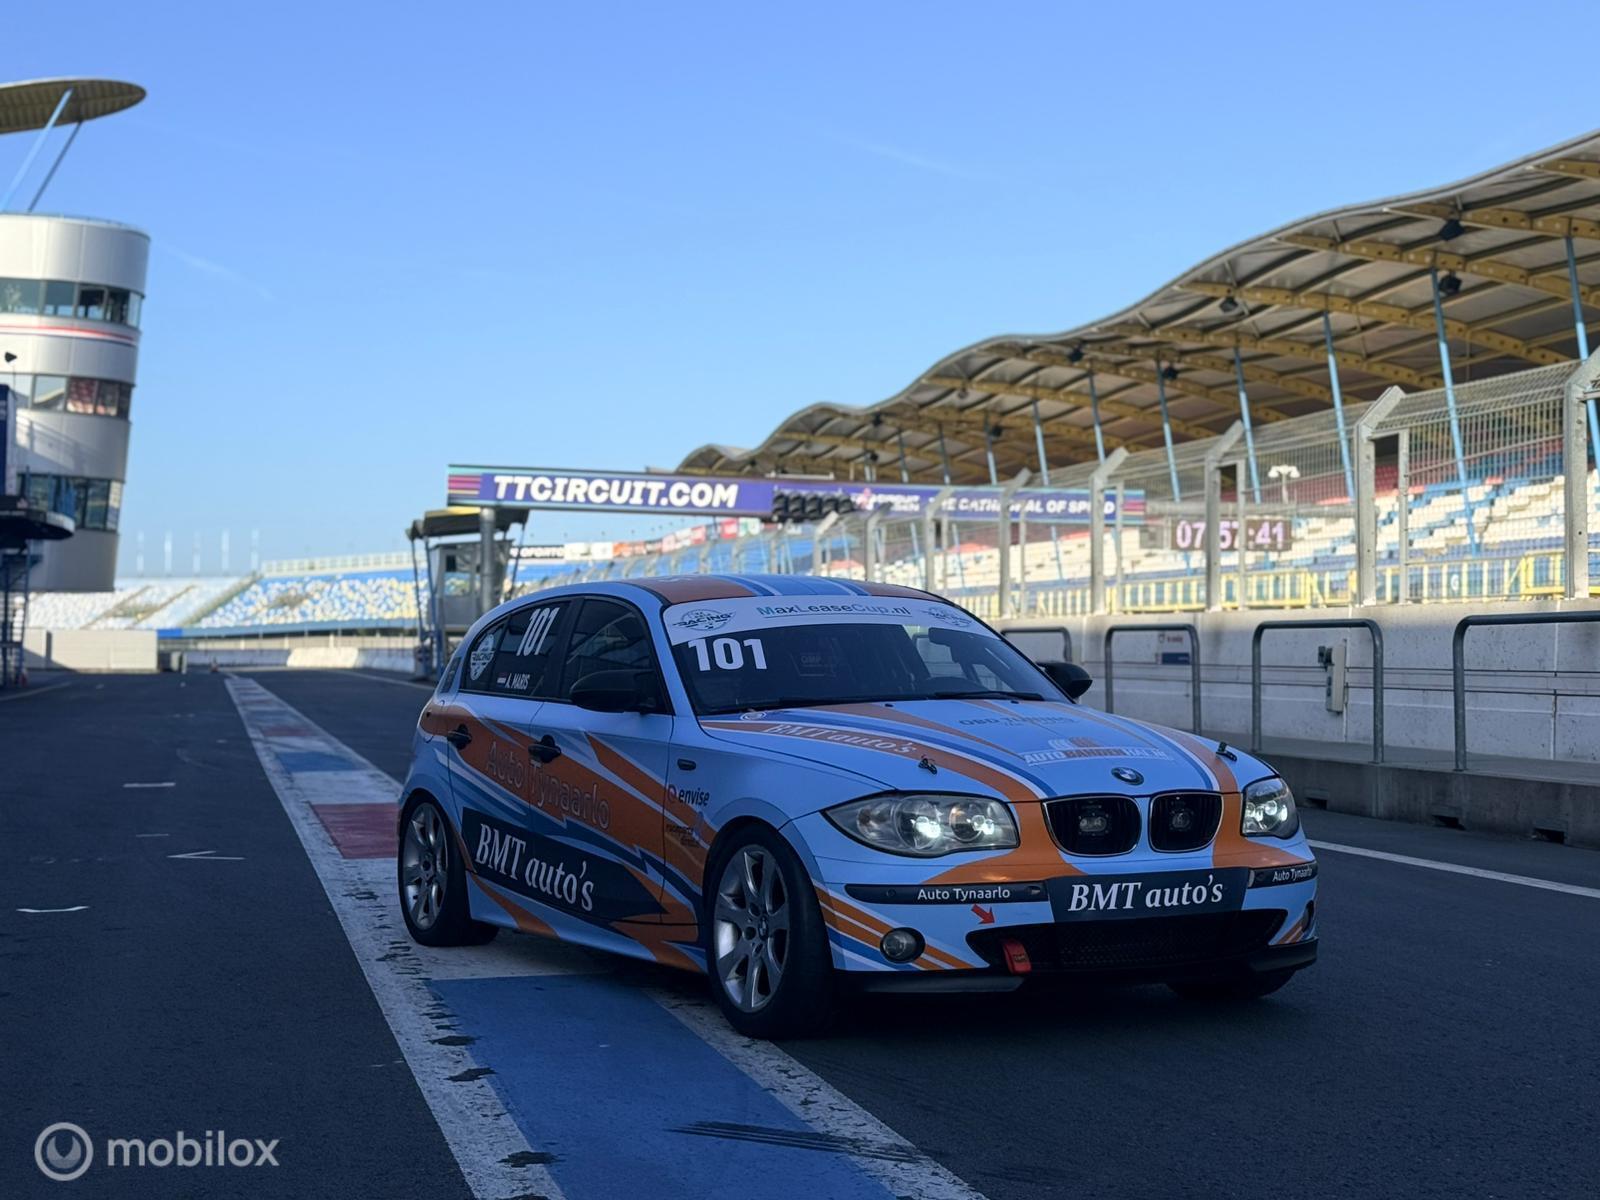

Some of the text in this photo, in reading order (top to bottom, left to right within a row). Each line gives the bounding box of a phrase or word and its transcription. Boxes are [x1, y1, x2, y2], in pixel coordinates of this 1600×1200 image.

[494, 476, 738, 508] TTCIRCUIT.COM
[1045, 500, 1067, 513] OF
[756, 604, 910, 616] MaxLeaseCup.nl
[516, 607, 560, 656] 101
[687, 638, 767, 671] 101
[486, 741, 609, 829] Auto Tynaarlo
[679, 787, 710, 806] envise
[475, 823, 594, 912] BMT auto's
[1272, 871, 1290, 883] Auto
[917, 886, 1011, 902] Auto Tynaarlo
[1067, 874, 1223, 912] BMT auto's
